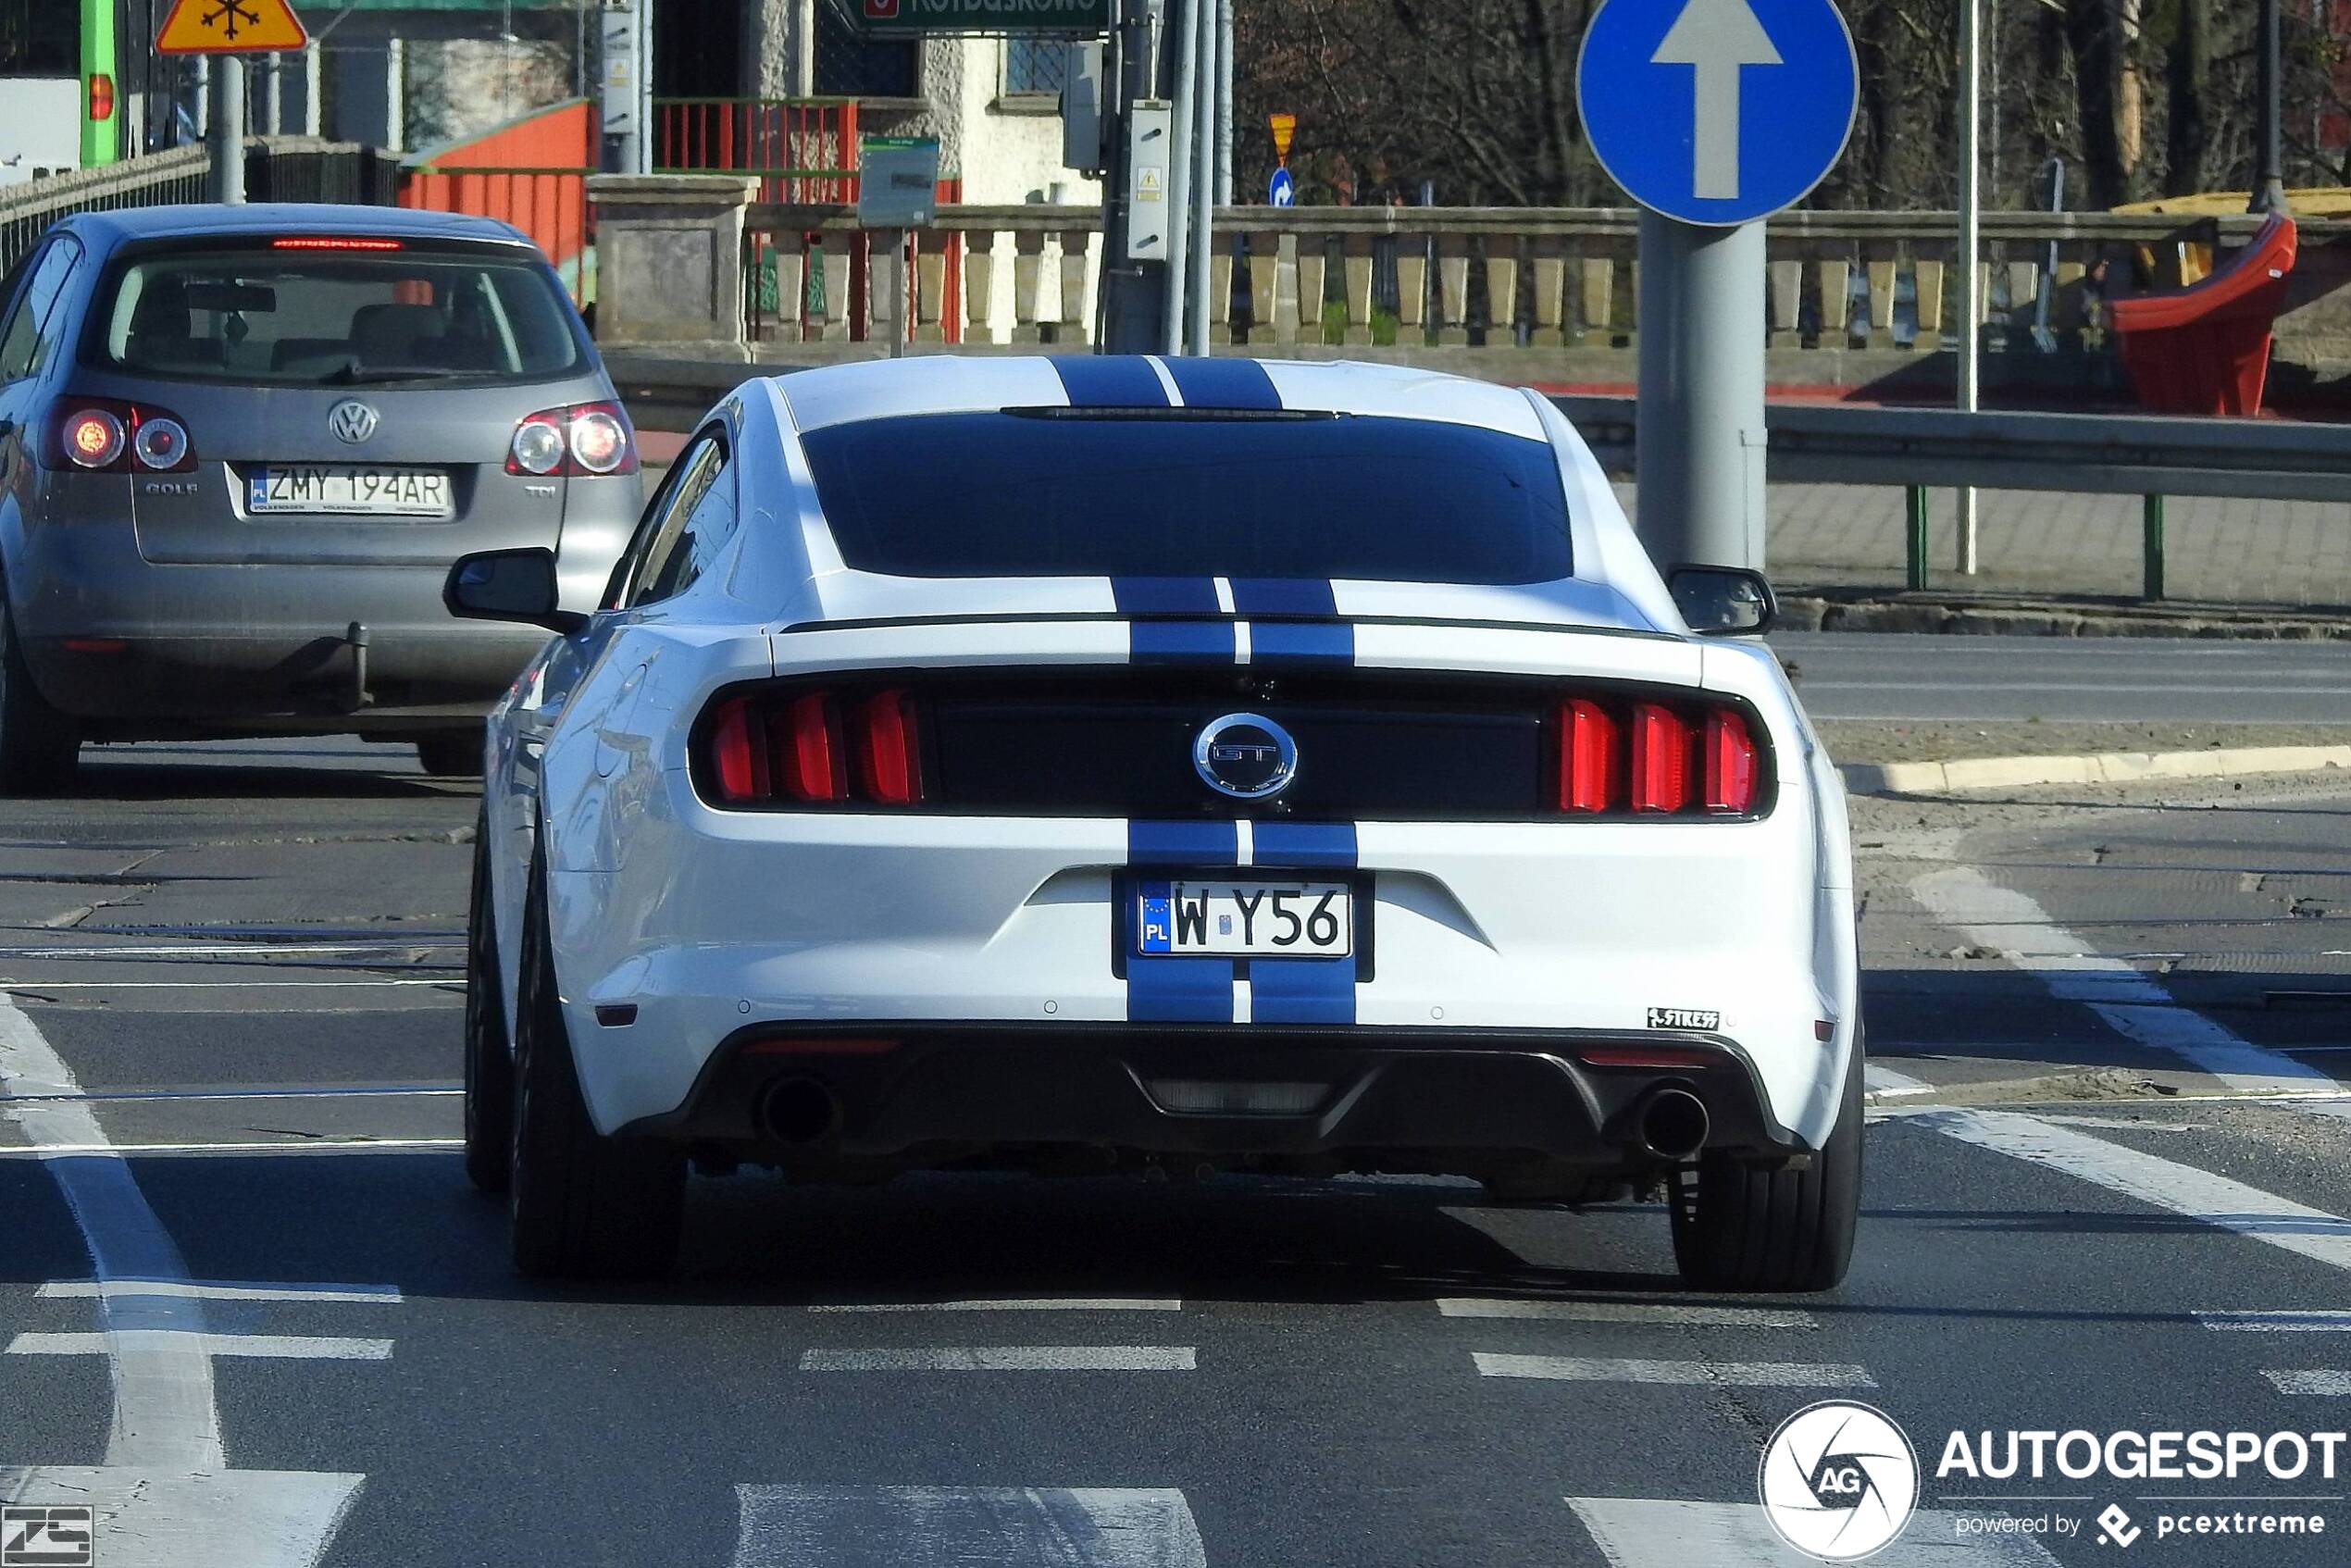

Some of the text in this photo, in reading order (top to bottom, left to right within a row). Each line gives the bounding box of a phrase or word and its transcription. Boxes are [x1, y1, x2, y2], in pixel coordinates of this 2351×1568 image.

[145, 482, 198, 495] GOLF
[254, 489, 266, 498] PL
[269, 468, 442, 504] ZMY 194AR
[1213, 744, 1276, 762] GT
[1175, 889, 1338, 946] W Y56
[1146, 924, 1168, 940] PL
